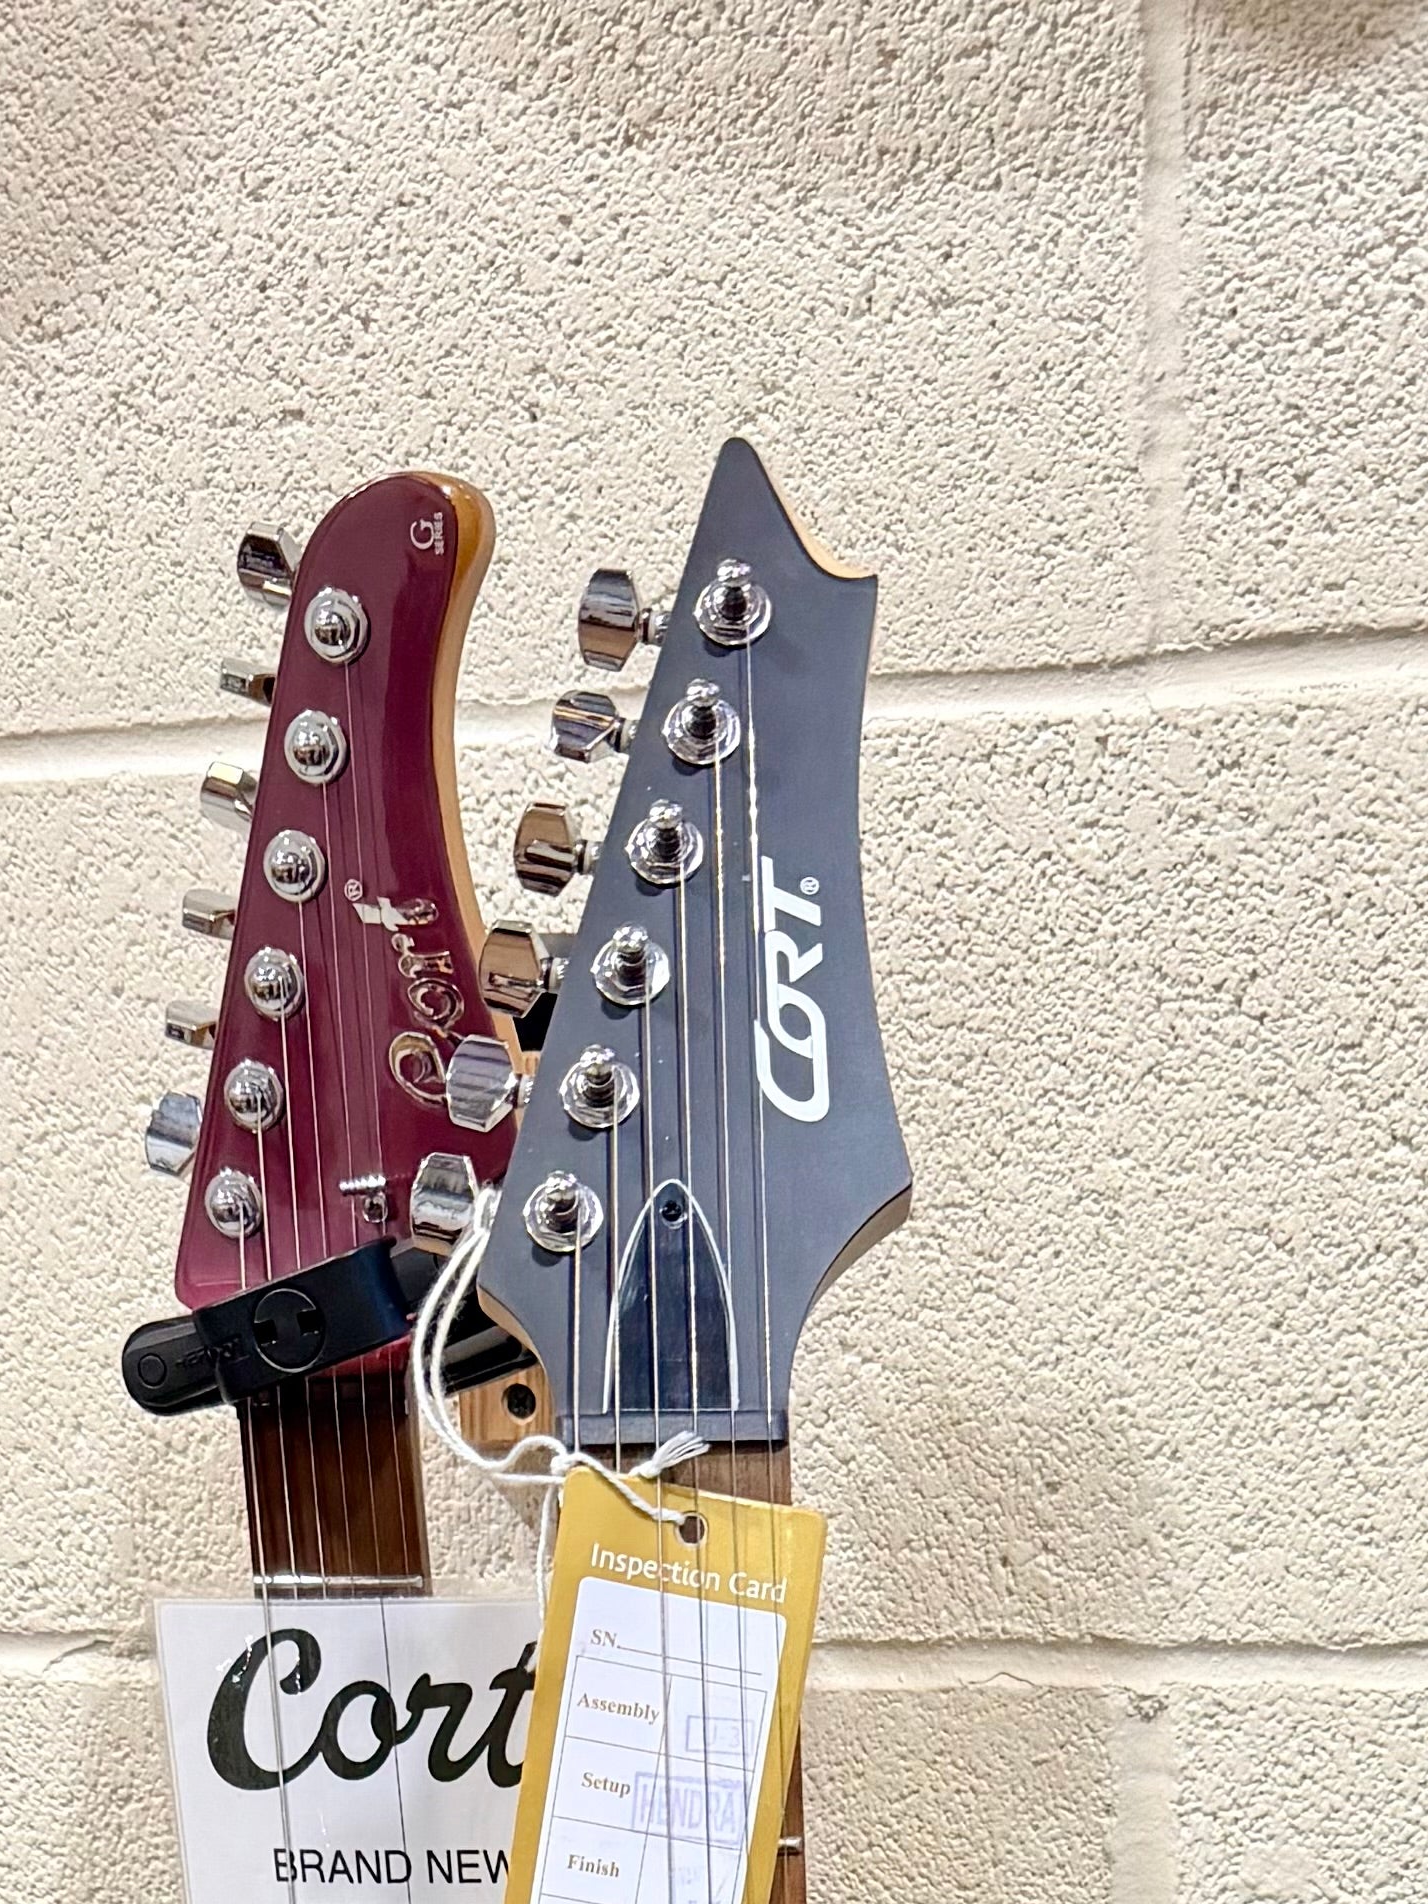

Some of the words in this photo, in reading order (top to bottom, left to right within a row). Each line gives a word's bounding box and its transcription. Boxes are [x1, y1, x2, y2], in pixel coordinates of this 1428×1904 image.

[410, 518, 434, 550] G
[433, 511, 445, 556] SERIES
[352, 895, 465, 1106] Cort
[754, 856, 830, 1123] CORT
[590, 1541, 721, 1592] Inspection
[729, 1571, 788, 1604] Card
[207, 1628, 538, 1790] Cort
[576, 1692, 660, 1725] Assembly
[581, 1771, 631, 1799] Setup
[273, 1848, 412, 1884] BRAND
[426, 1849, 509, 1884] NEW
[567, 1854, 620, 1879] Finish
